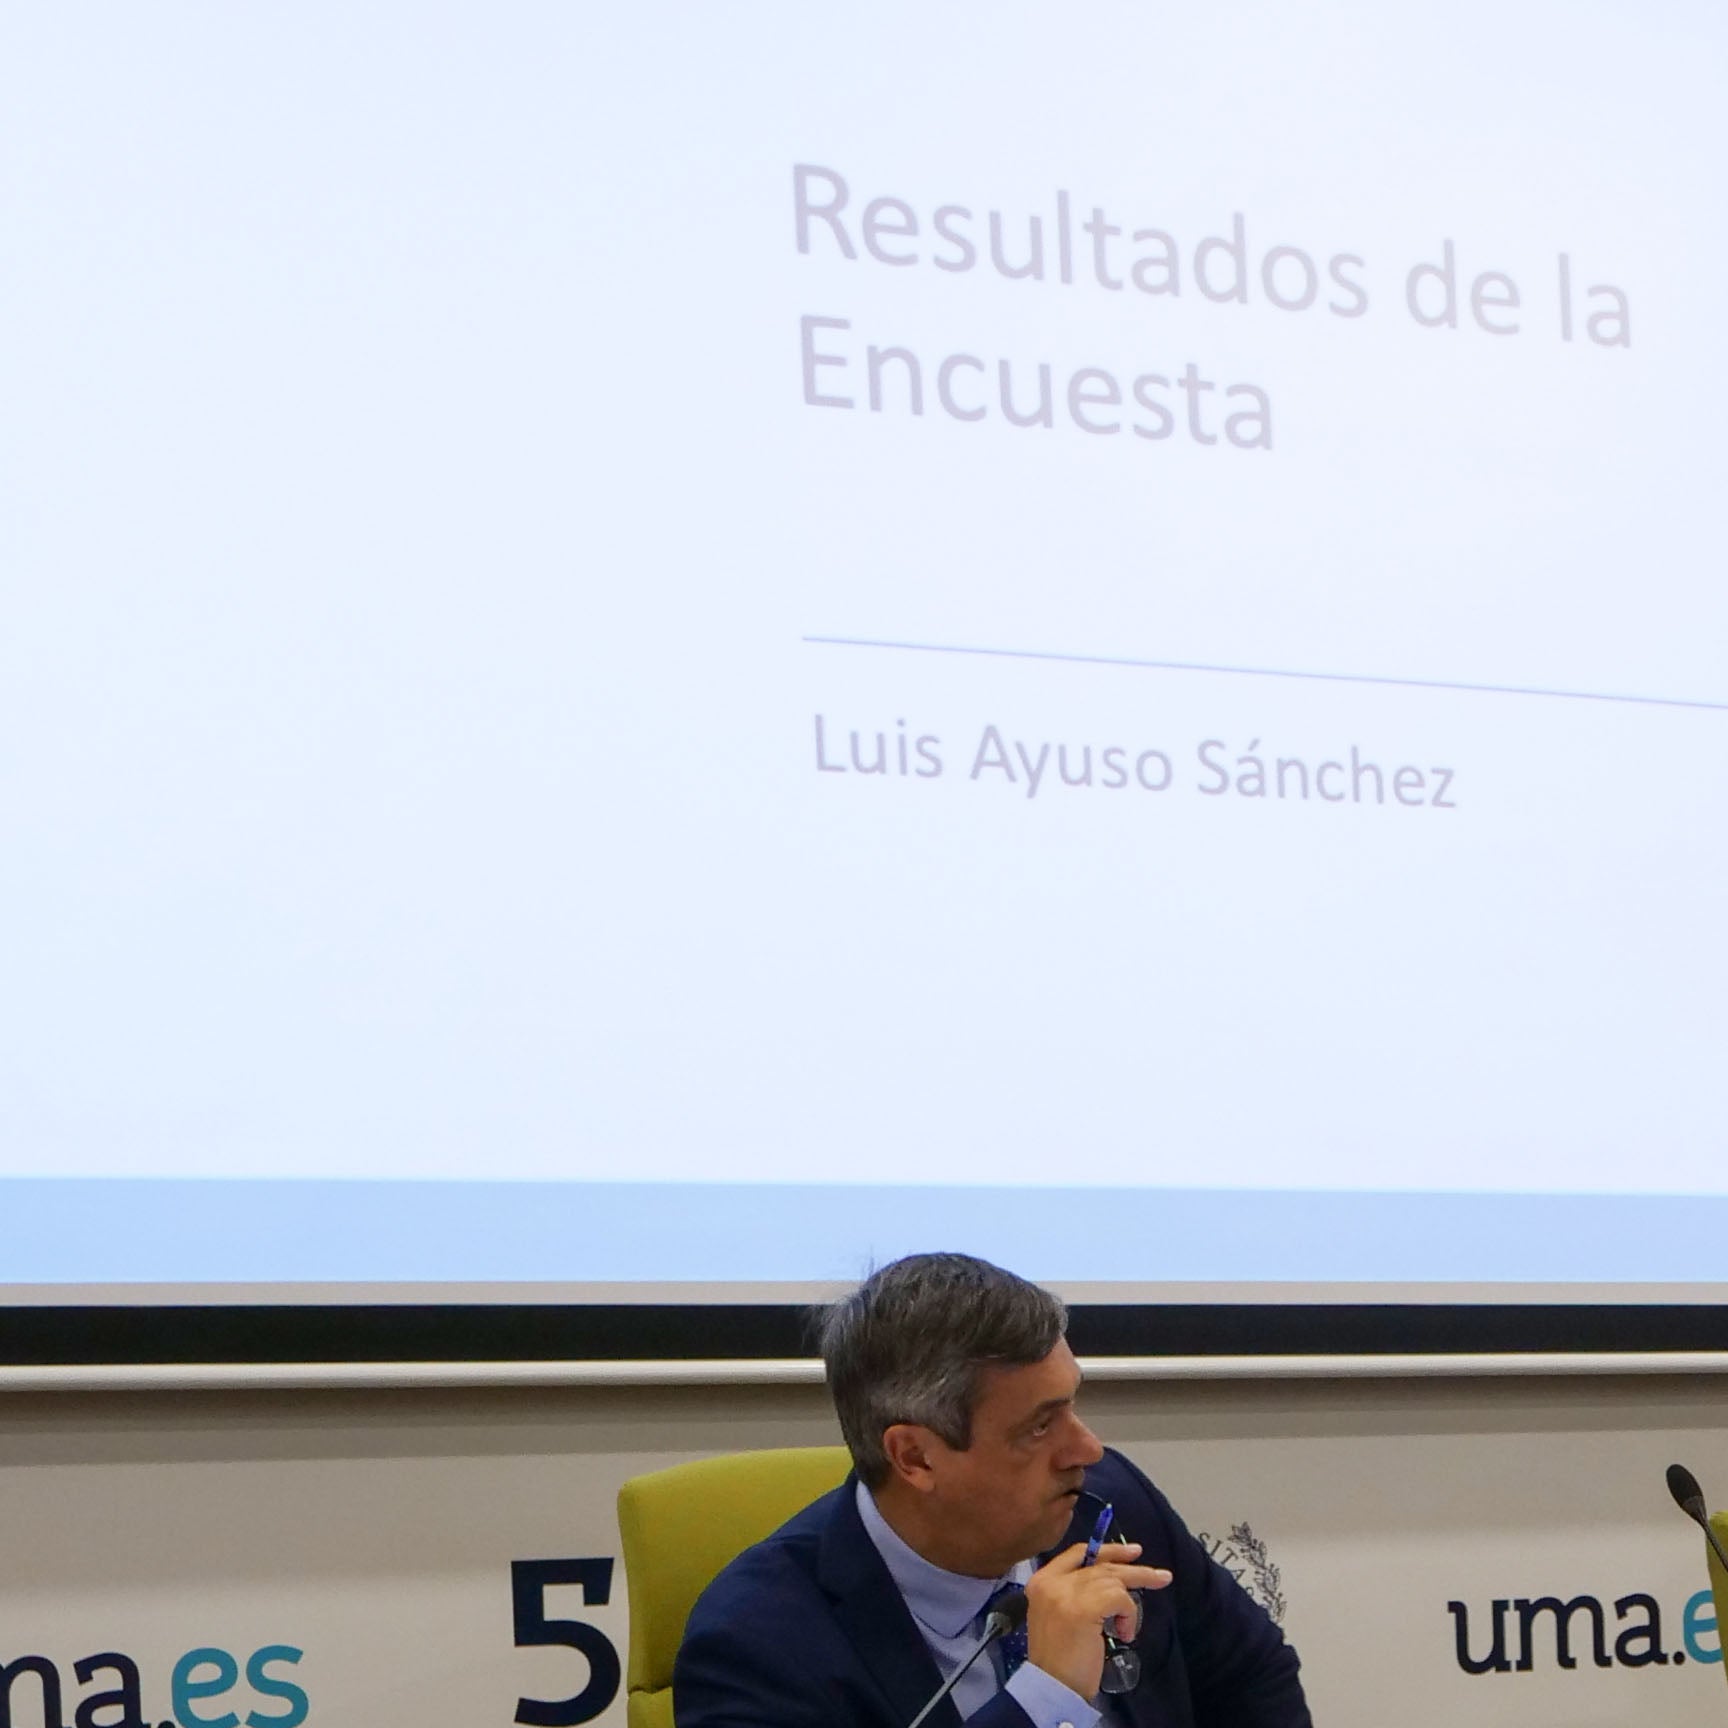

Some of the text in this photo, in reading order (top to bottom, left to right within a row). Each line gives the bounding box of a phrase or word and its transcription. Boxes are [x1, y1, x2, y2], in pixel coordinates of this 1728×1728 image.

[792, 162, 1634, 351] Resultados de la
[798, 314, 1275, 453] Encuesta
[813, 712, 1458, 811] Luis Ayuso Sánchez
